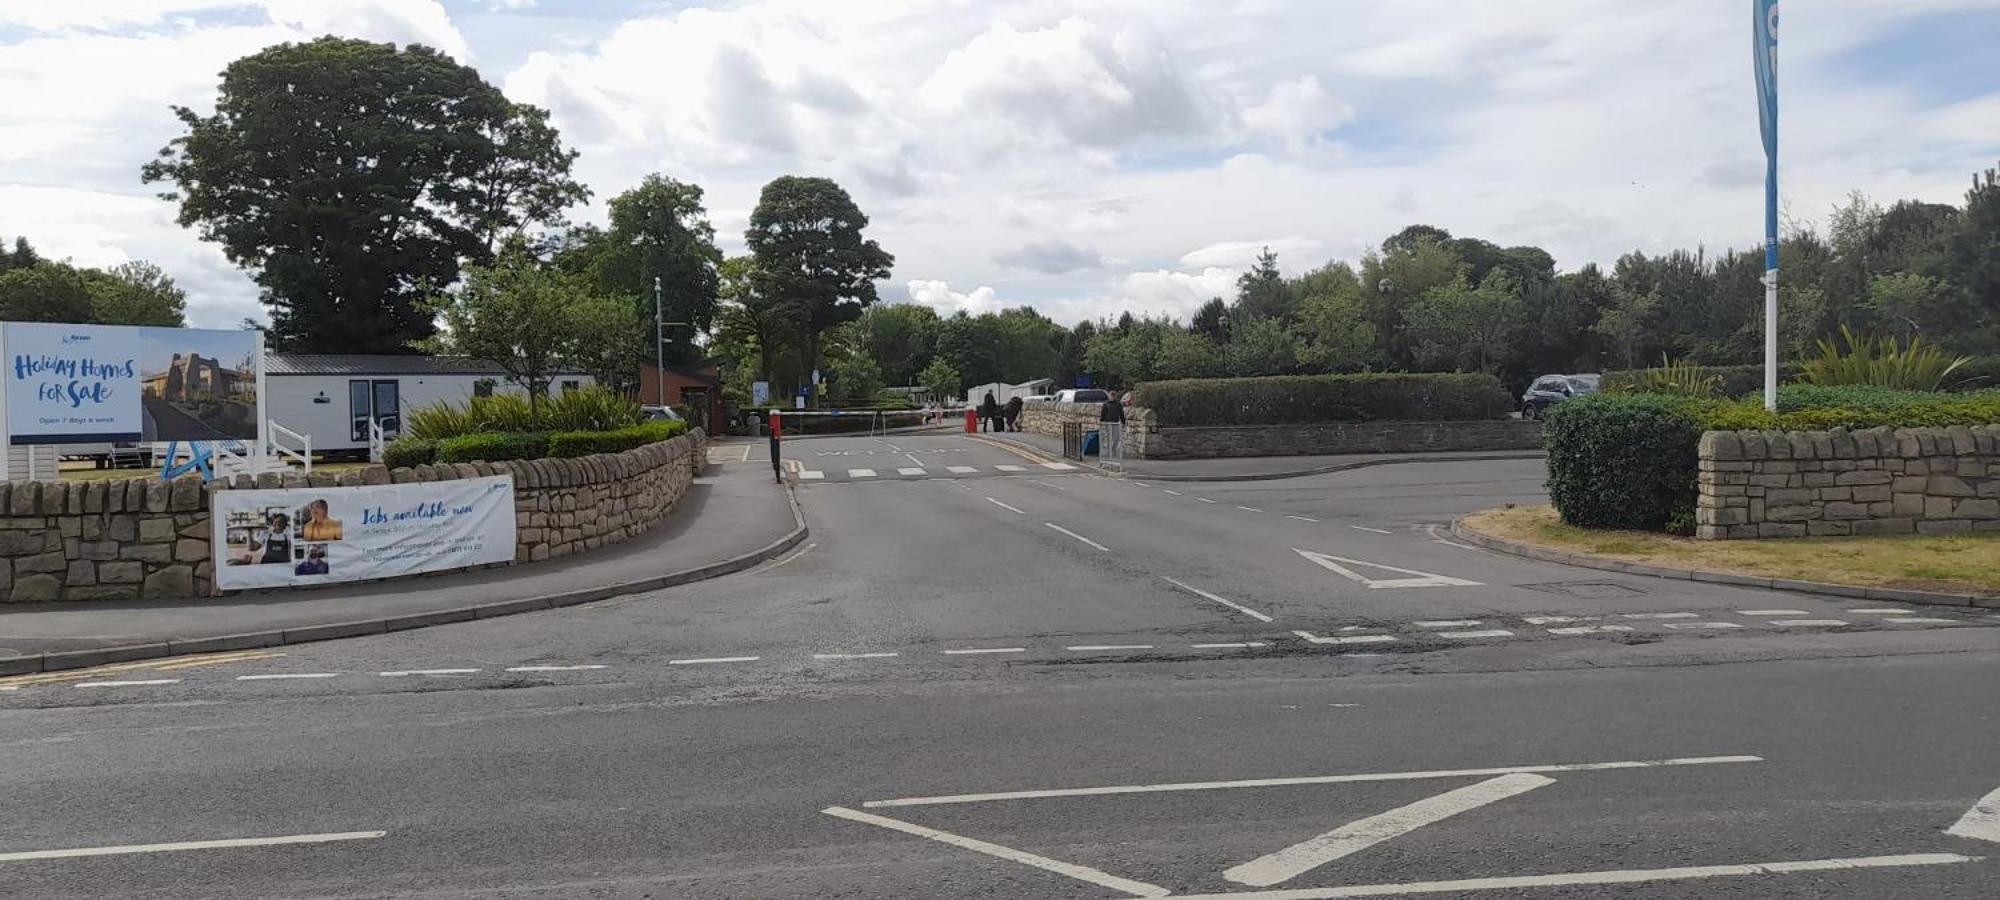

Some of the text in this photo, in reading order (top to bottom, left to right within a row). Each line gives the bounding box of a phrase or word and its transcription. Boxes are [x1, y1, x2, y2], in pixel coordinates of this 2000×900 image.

[67, 380, 113, 408] Sale
[361, 506, 388, 524] Jobs
[393, 501, 448, 520] available
